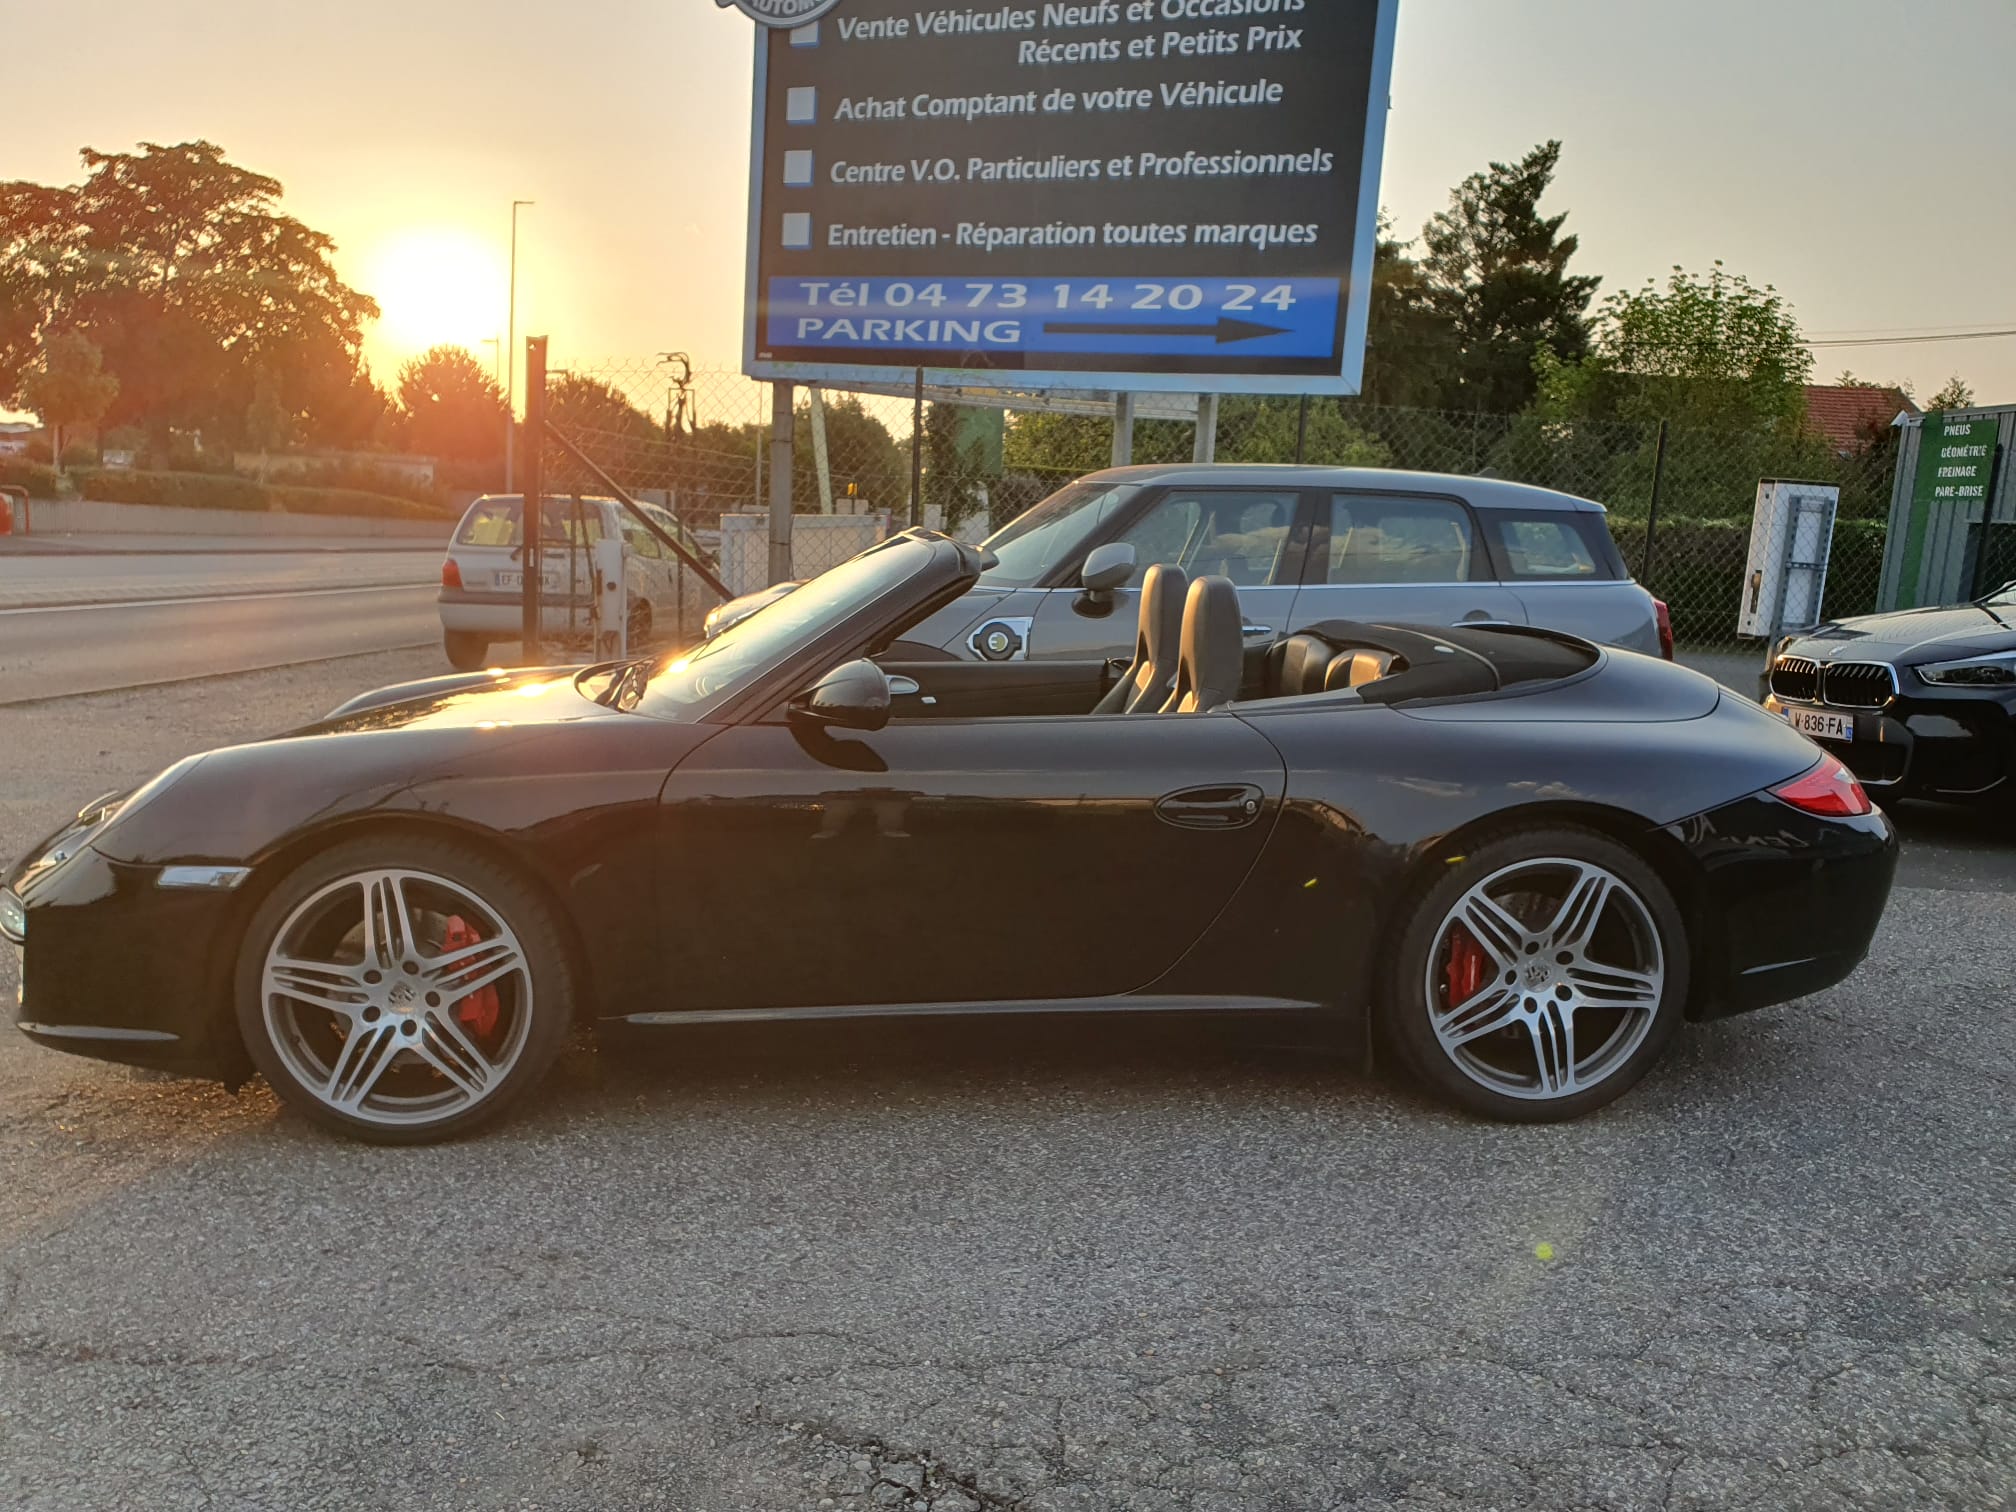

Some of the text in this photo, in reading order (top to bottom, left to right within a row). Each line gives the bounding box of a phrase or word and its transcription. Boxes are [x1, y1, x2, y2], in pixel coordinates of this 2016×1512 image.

[836, 0, 1305, 40] Vente Véhicules Neufs et Occasions
[1018, 24, 1304, 64] Récents et Petits Prix
[833, 78, 1285, 121] Achat Comptant de votre Véhicule
[830, 147, 1335, 184] Centre V.O. Particuliers et Professionnels
[828, 223, 937, 246] Entretien
[955, 221, 1096, 252] Réparation
[1102, 222, 1187, 244] toutes
[1194, 223, 1319, 250] marques
[799, 282, 1296, 311] Tél 04 73 14 20 24
[797, 318, 1021, 343] PARKING
[1943, 424, 1971, 437] PNEUS
[1941, 443, 1988, 458] GÉOMÉTRIE
[1937, 465, 1978, 478] FREINAGE
[1934, 485, 1984, 497] PARE-BRISE
